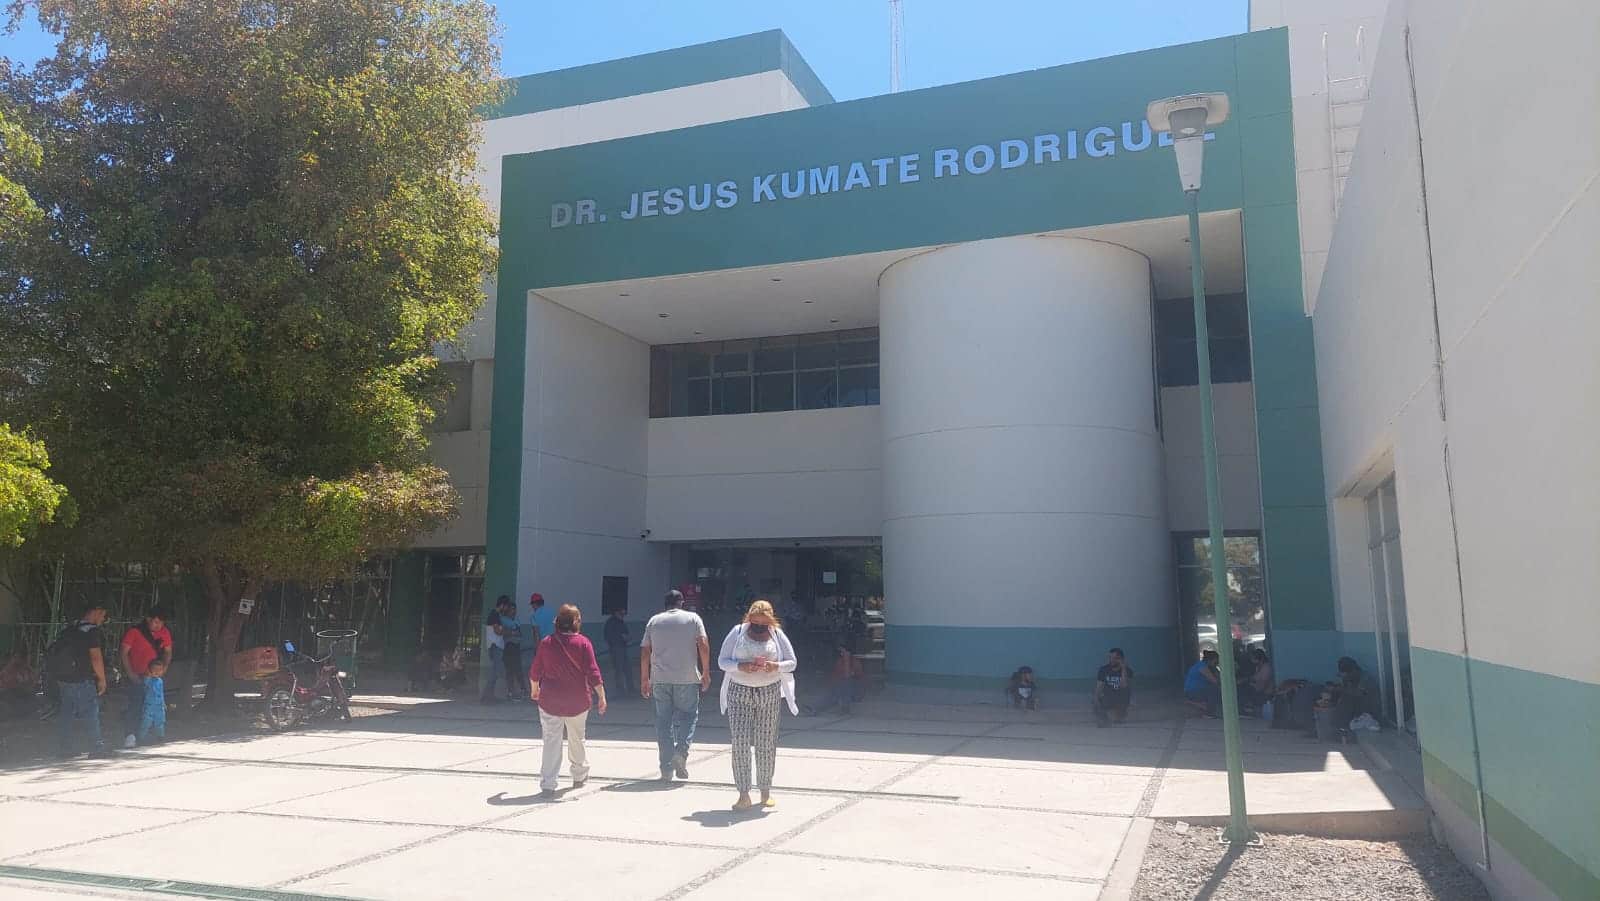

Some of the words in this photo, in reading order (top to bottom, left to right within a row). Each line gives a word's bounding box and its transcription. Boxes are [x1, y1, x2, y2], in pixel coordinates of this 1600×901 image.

[550, 199, 607, 229] DR.
[621, 181, 738, 220] JESUS
[752, 154, 920, 203] KUMATE
[934, 120, 1216, 178] RODRIGU
